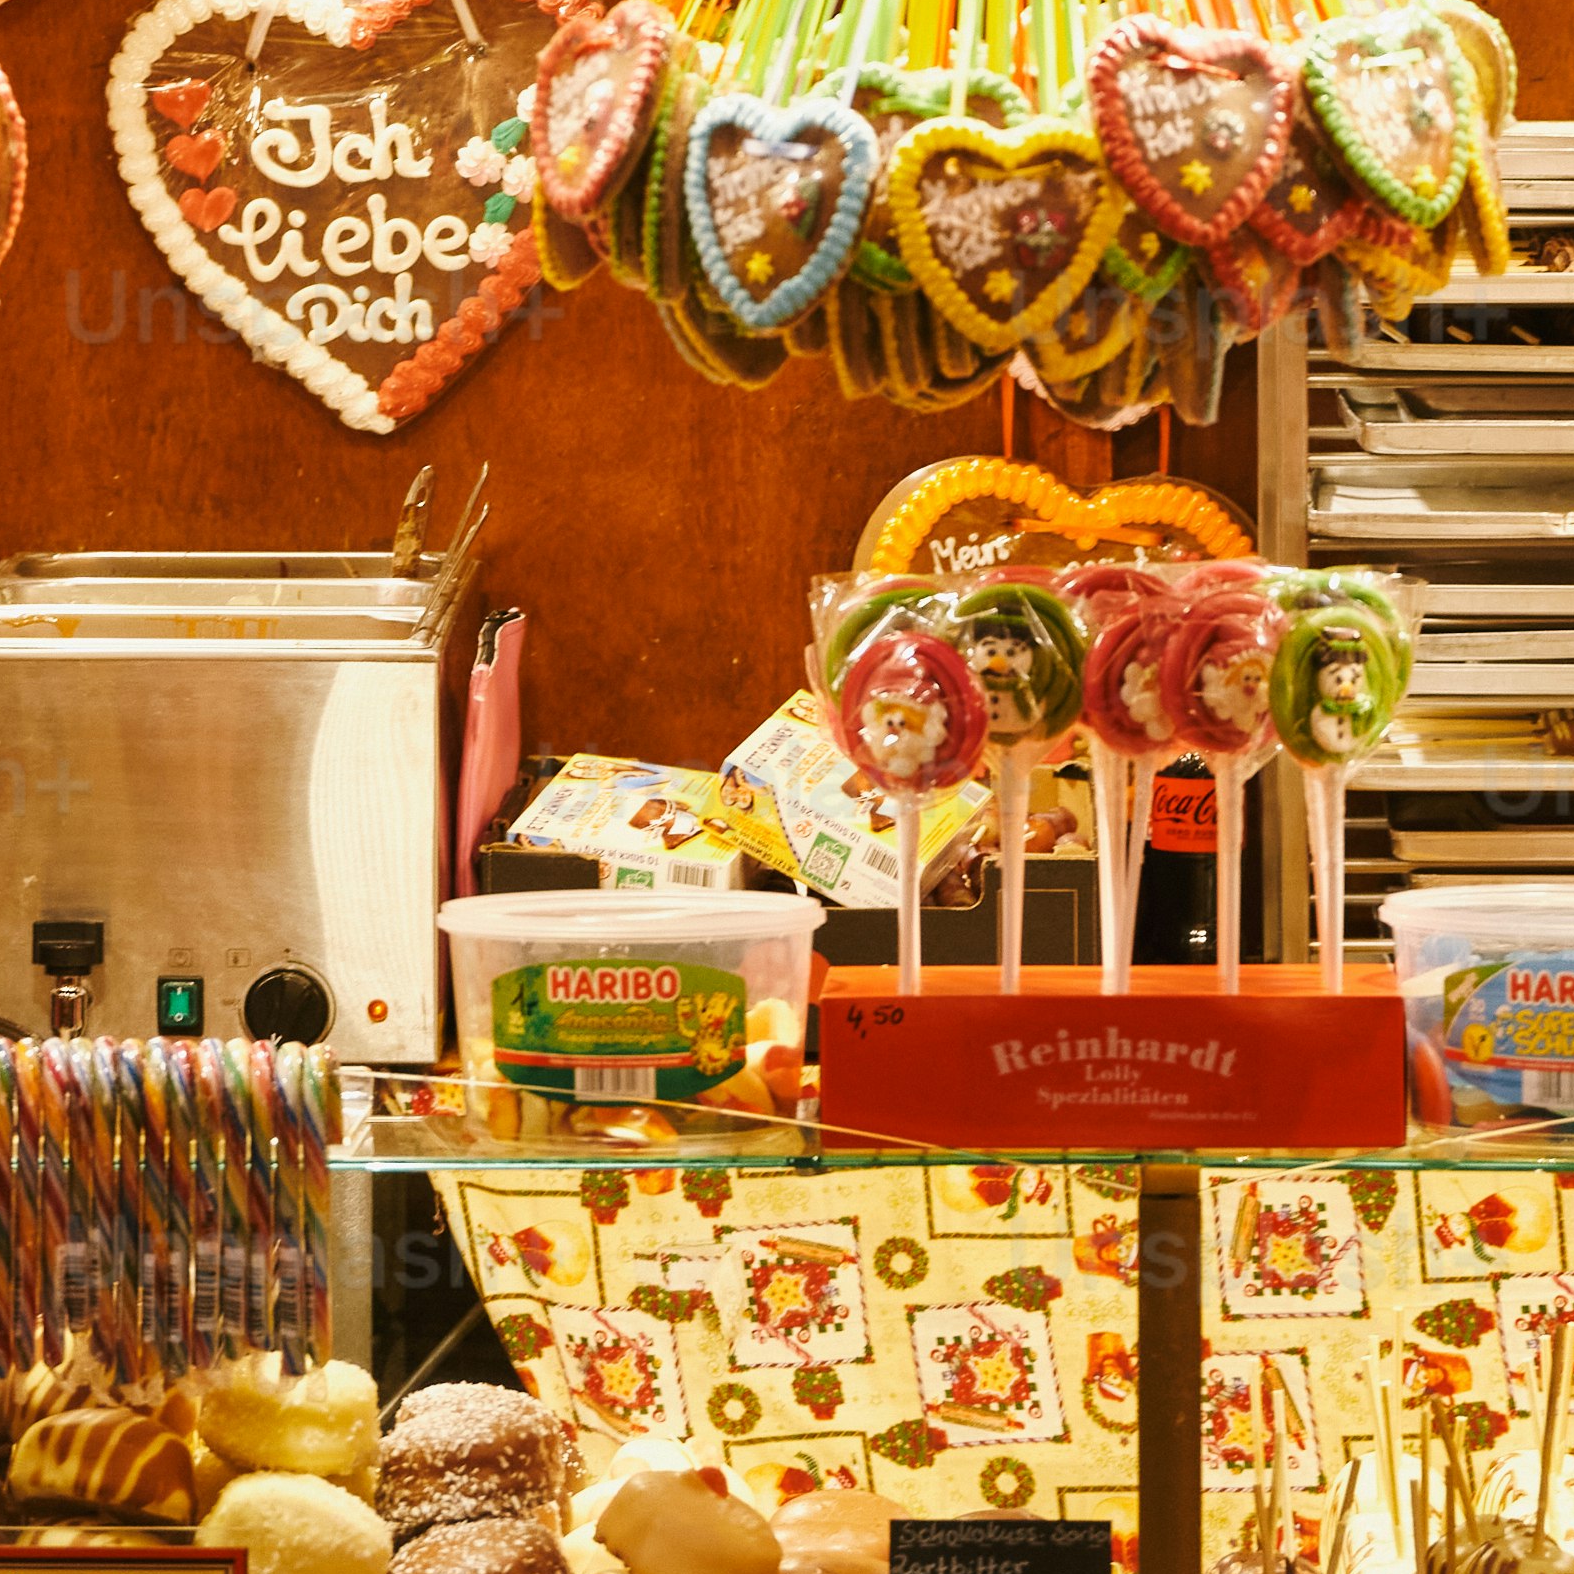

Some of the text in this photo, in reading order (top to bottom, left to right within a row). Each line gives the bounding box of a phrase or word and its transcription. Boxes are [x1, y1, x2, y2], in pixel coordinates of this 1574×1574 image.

[250, 97, 434, 188] Ich
[217, 192, 471, 283] liebe
[285, 271, 434, 345] Dich
[549, 966, 679, 1003] HARIBO
[990, 1025, 1238, 1077] Reinhardt
[1084, 1063, 1142, 1086] Lolly
[1036, 1085, 1190, 1110] Spezialitäten
